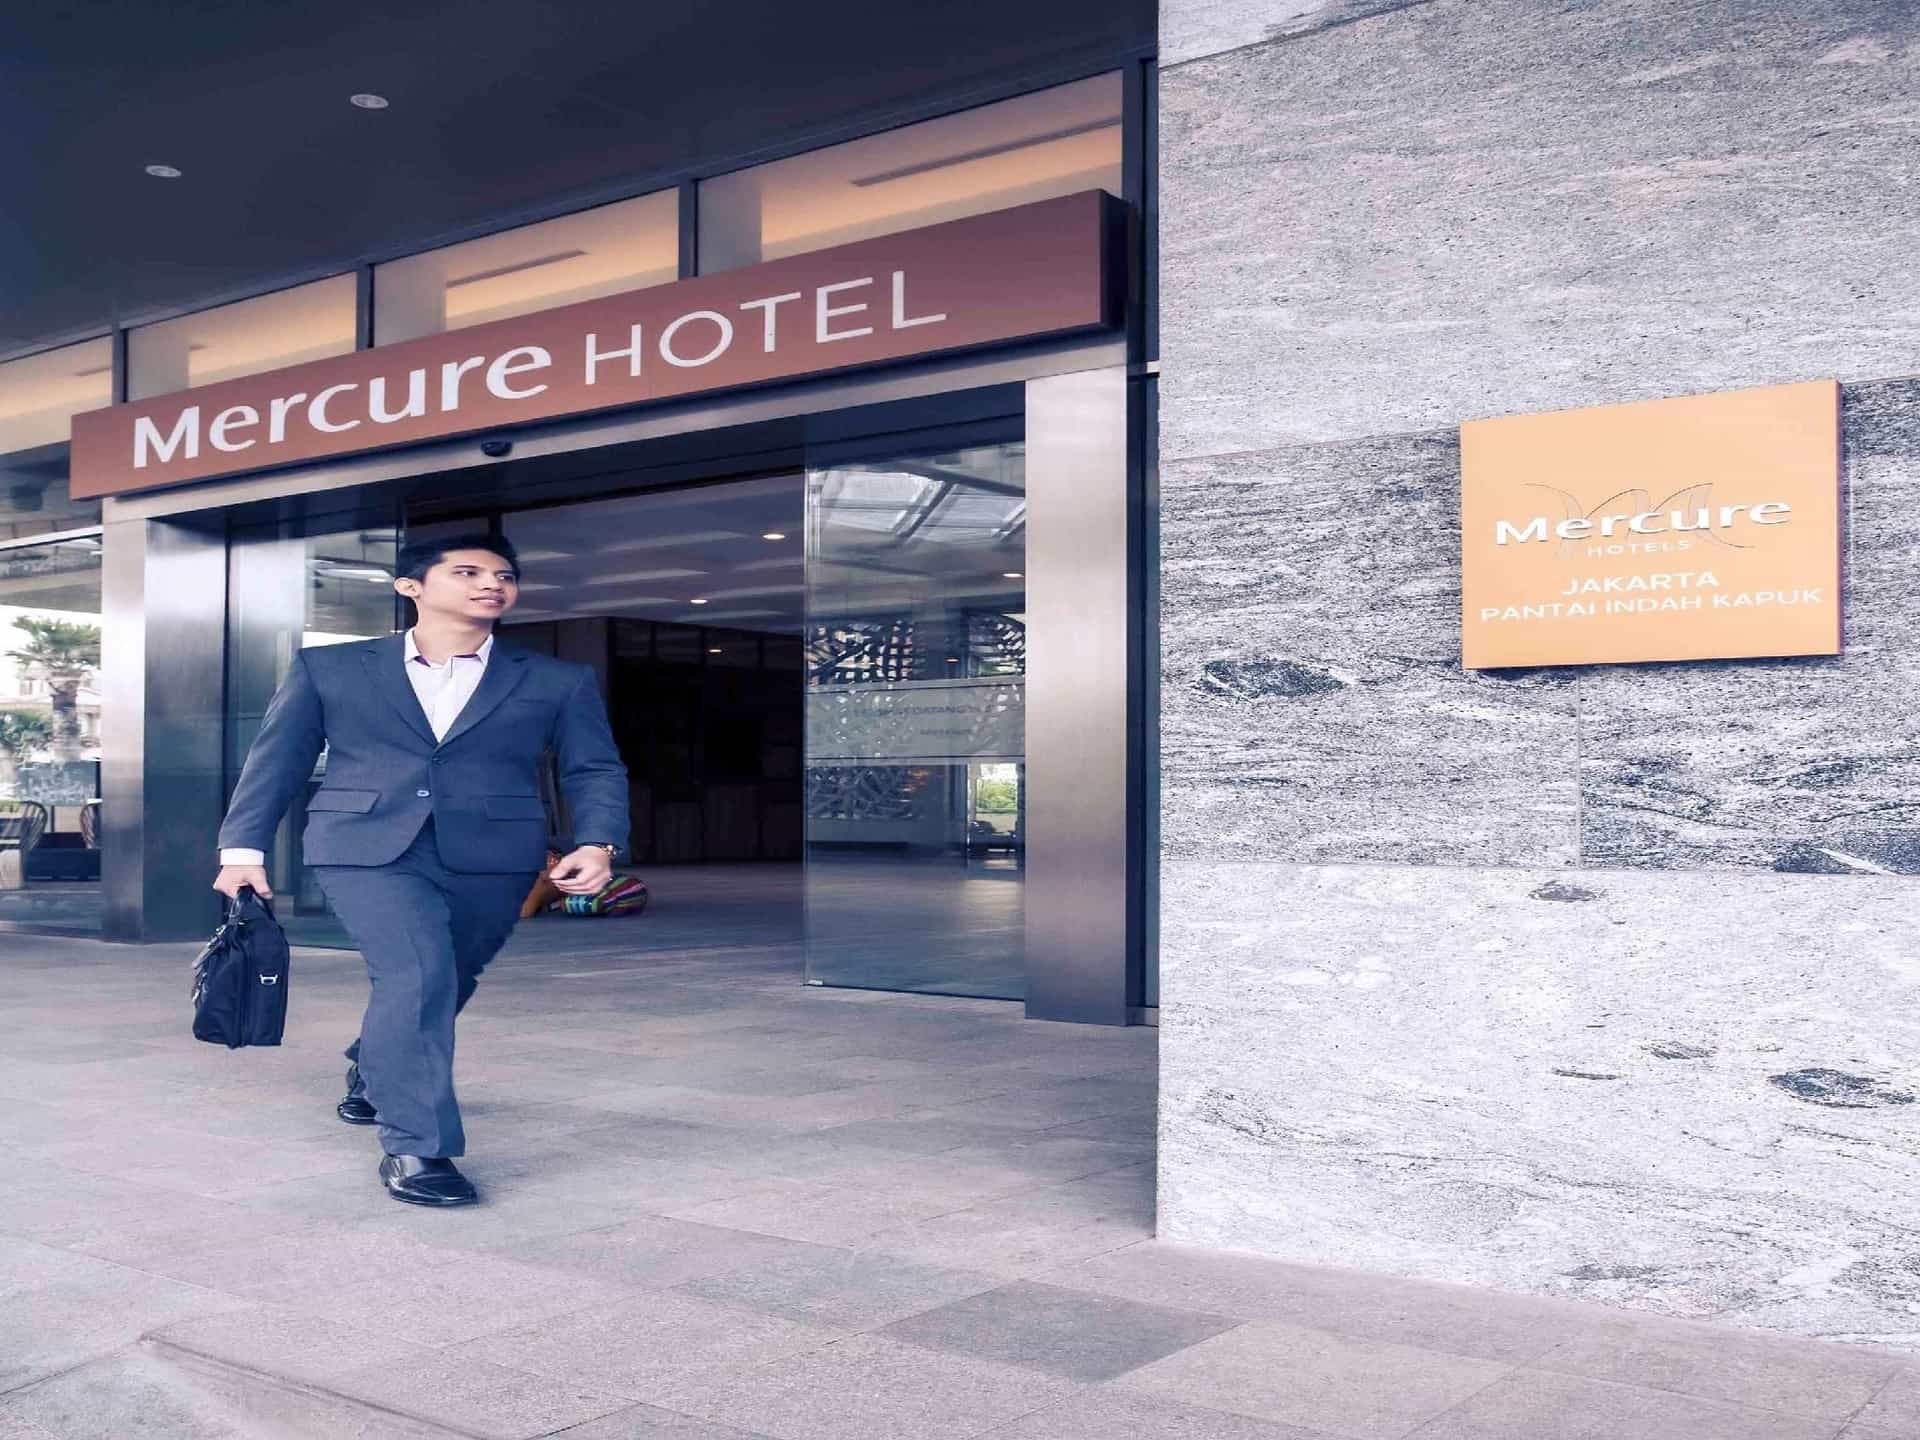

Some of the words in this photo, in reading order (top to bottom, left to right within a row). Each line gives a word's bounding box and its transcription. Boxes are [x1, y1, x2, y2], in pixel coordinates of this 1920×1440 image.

[133, 345, 553, 469] Mercure
[584, 270, 947, 385] HOTEL
[1494, 501, 1792, 546] Mercure
[1586, 539, 1692, 558] HOTELS
[1561, 570, 1719, 596] JAKARTA
[1480, 601, 1595, 622] PANTAI
[1605, 595, 1702, 616] INDAH
[1712, 587, 1824, 609] KAPUK
